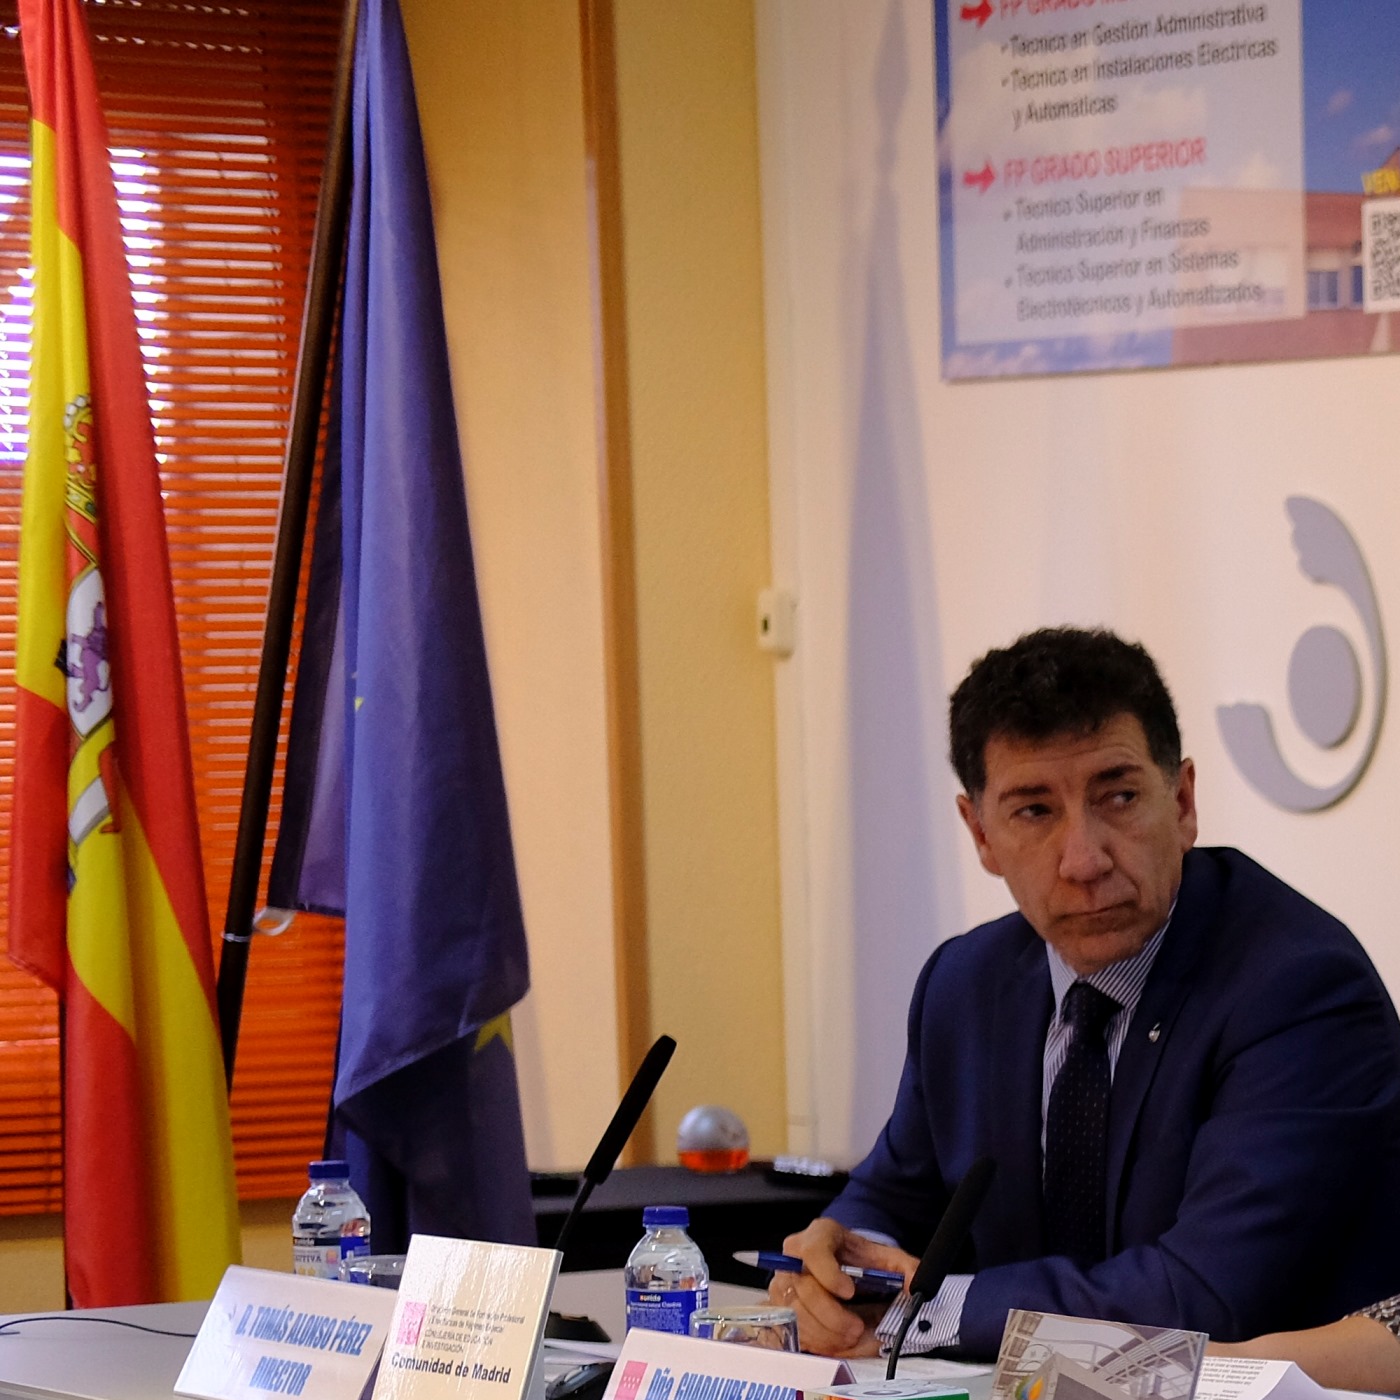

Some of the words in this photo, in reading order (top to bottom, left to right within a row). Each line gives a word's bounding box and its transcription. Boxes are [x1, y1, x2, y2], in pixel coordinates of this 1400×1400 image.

[1070, 28, 1088, 48] en
[1154, 2, 1268, 38] Administrativa
[1070, 63, 1088, 83] en
[1094, 49, 1193, 81] Instalaciones
[1011, 110, 1022, 132] y
[1003, 157, 1028, 188] FP
[1031, 150, 1099, 185] GRADO
[1103, 137, 1209, 177] SUPERIOR
[1143, 186, 1164, 207] en
[1129, 229, 1139, 249] y
[1140, 216, 1212, 242] Finanzas
[1144, 256, 1164, 274] en
[1167, 249, 1240, 273] Sistemas
[235, 1304, 254, 1336] D.
[248, 1304, 295, 1343] TOMÁS
[284, 1313, 338, 1351] ALONSO
[328, 1315, 373, 1356] PÉREZ
[249, 1355, 312, 1396] DIRECTOR
[391, 1352, 454, 1375] Comunidad
[454, 1361, 469, 1378] de
[472, 1363, 512, 1384] Madrid
